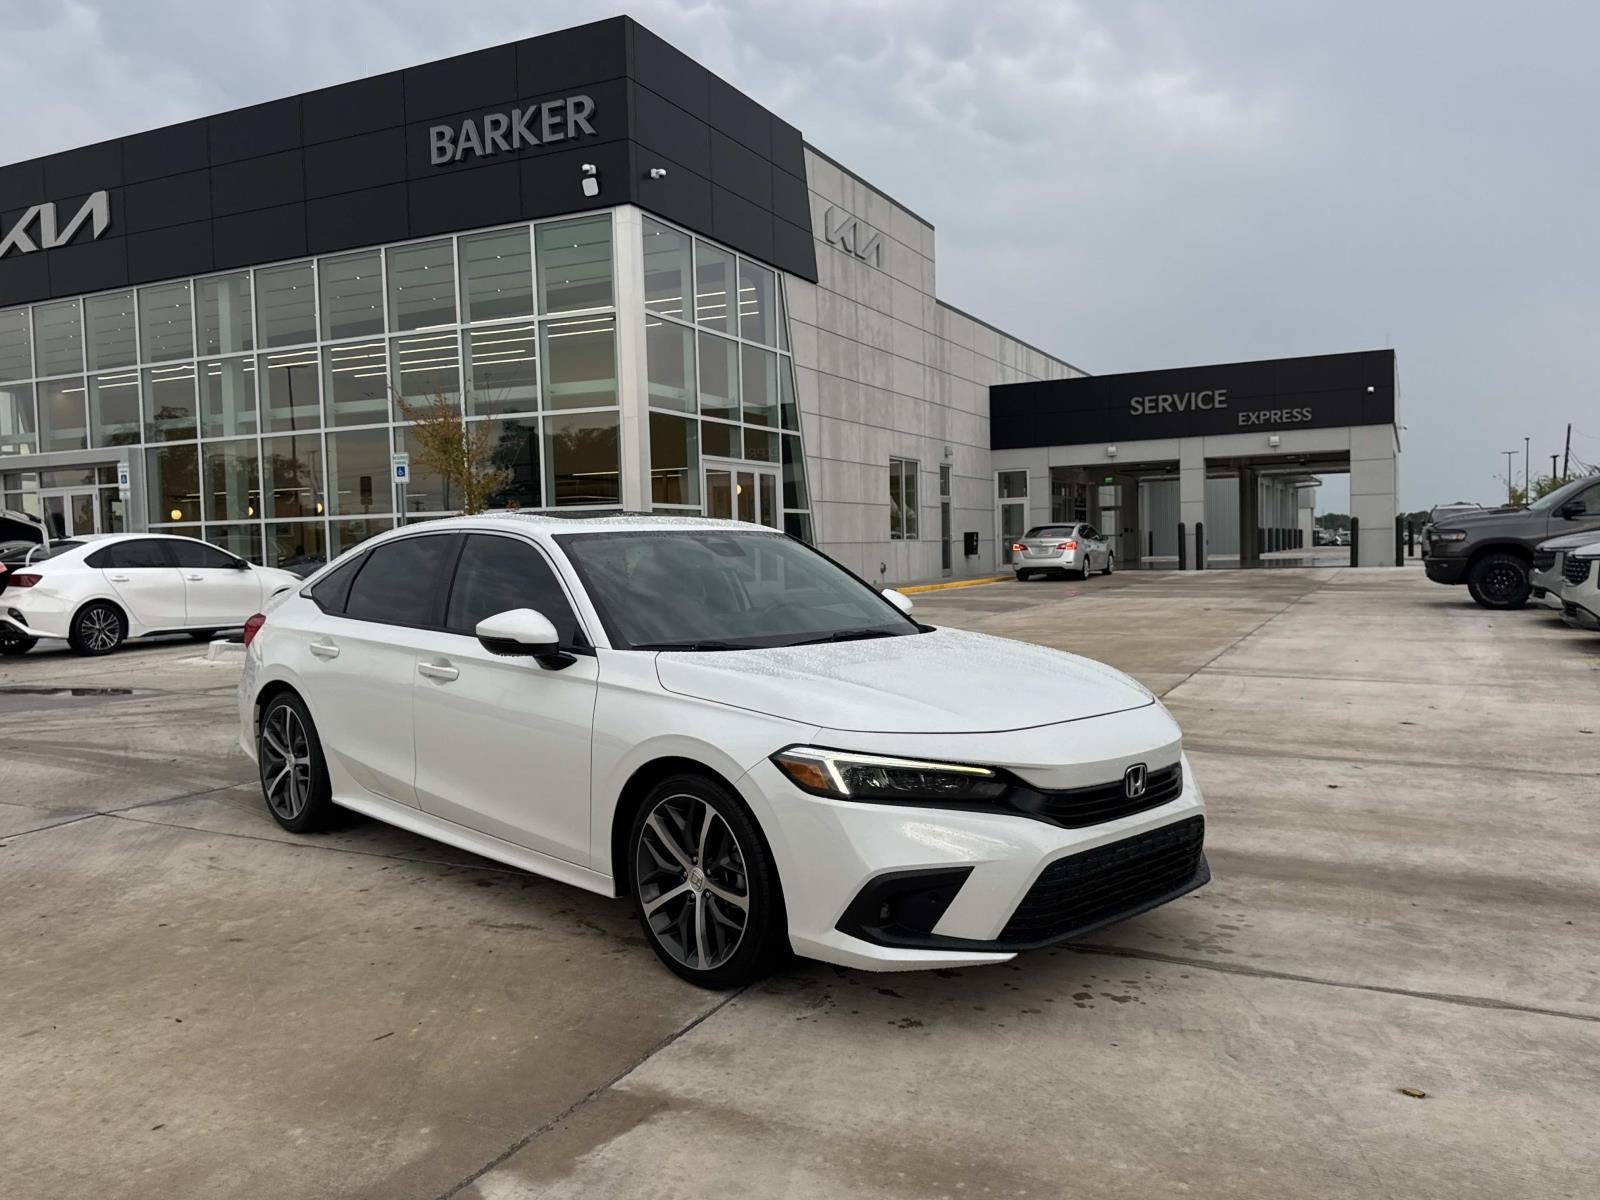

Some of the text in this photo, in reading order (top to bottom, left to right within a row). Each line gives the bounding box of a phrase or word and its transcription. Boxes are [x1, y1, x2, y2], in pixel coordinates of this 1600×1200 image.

[429, 94, 597, 165] BARKER
[825, 206, 880, 267] KIA
[1130, 389, 1228, 416] SERVICE
[1238, 407, 1312, 426] EXPRESS
